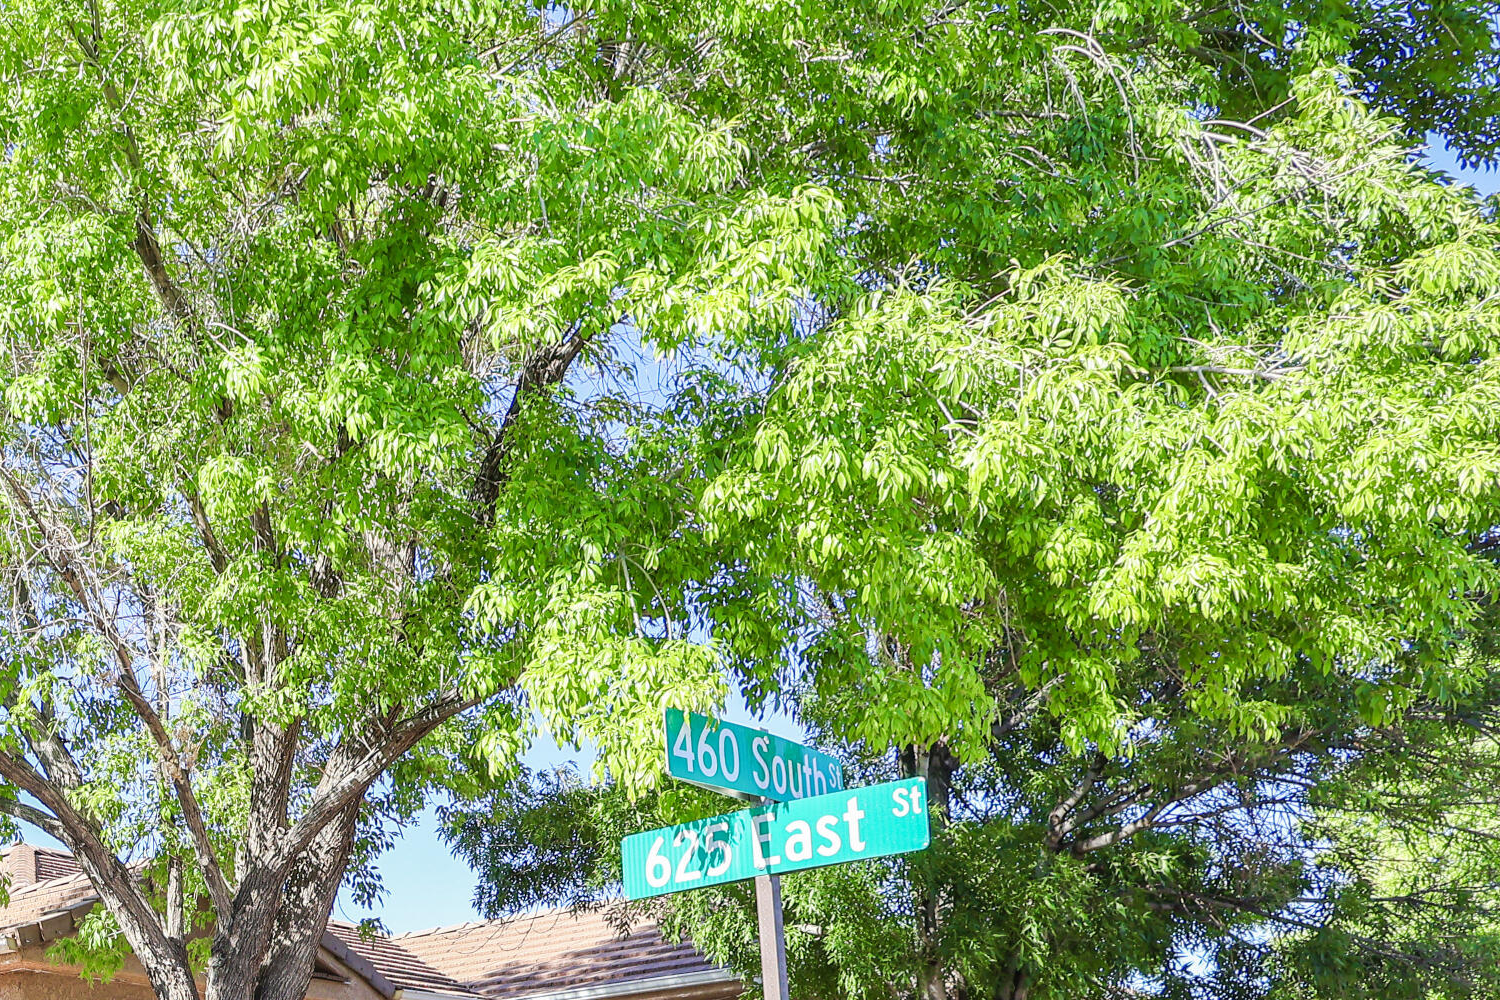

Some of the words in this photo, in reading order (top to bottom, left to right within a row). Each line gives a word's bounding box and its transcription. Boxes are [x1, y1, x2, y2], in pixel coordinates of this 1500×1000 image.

[673, 722, 740, 782] 460
[752, 736, 828, 799] South
[829, 763, 842, 790] St
[645, 822, 733, 888] 625
[750, 797, 867, 868] East
[892, 785, 922, 818] St
